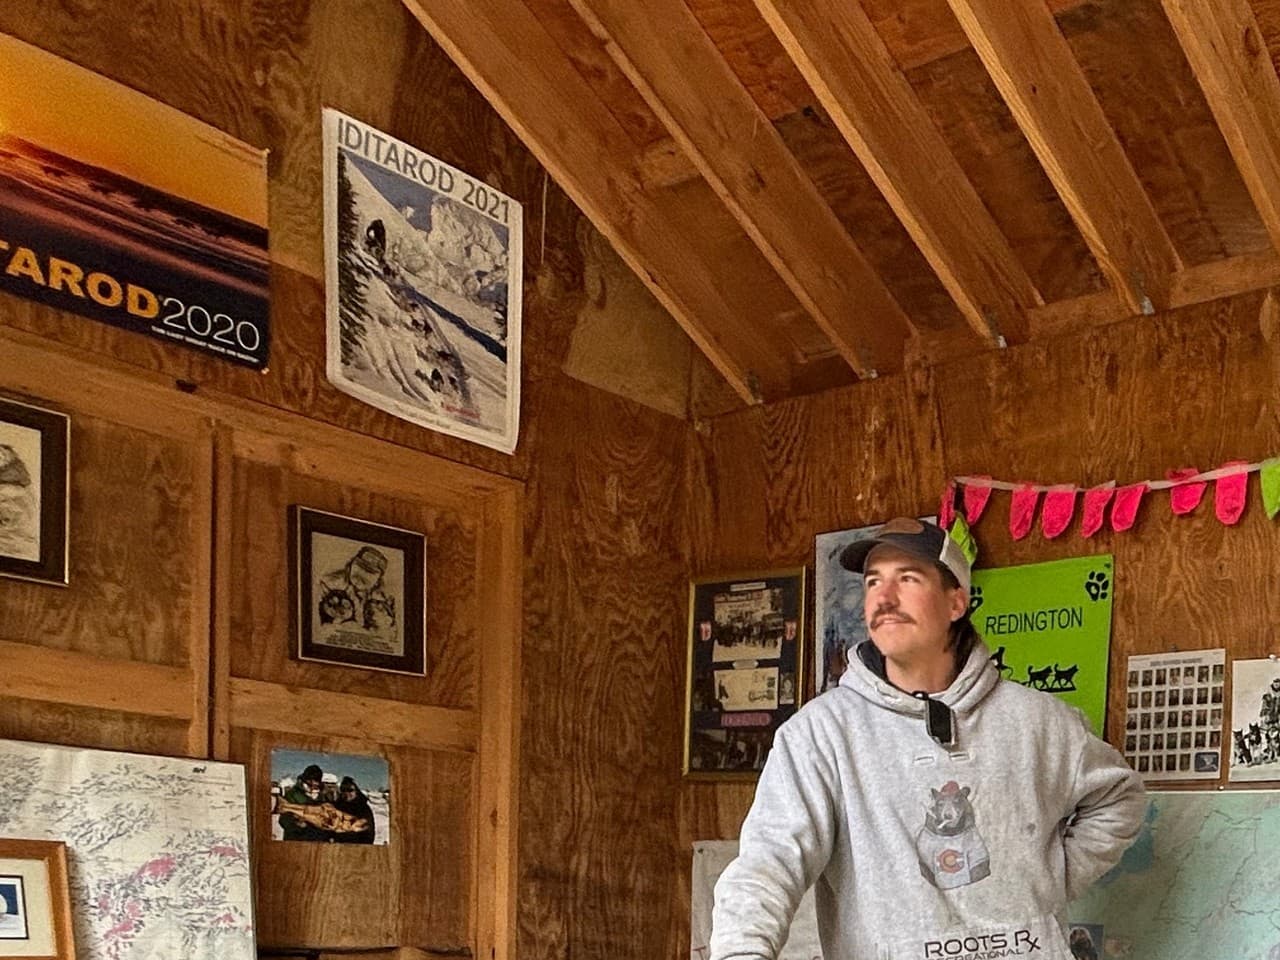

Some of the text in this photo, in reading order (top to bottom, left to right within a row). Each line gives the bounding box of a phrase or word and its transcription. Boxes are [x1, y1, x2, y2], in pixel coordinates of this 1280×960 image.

[337, 118, 510, 224] IDITAROD 2021
[0, 241, 159, 319] AROD
[984, 607, 1083, 636] REDINGTON
[924, 933, 1008, 958] ROOTS
